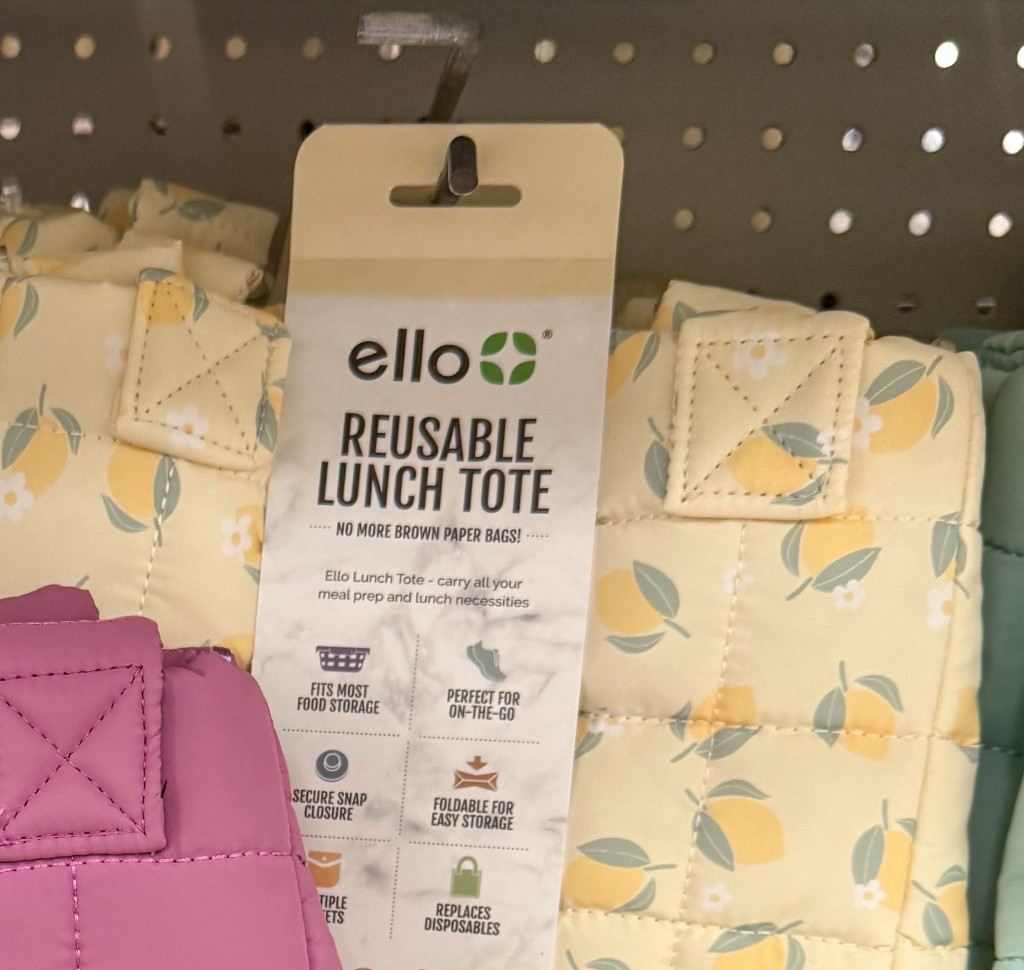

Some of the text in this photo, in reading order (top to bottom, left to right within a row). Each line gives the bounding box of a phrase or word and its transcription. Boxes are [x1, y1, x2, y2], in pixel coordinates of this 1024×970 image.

[348, 328, 470, 385] ello
[340, 412, 537, 463] REUSABLE
[317, 461, 553, 514] LUNCH TOTE
[336, 522, 521, 544] NO MORE BROWN PAPER BAGS!
[325, 571, 349, 582] Ello
[352, 571, 393, 585] Lunch
[396, 573, 425, 586] Tote
[437, 577, 471, 590] carry
[474, 576, 490, 589] all
[492, 578, 522, 591] your
[318, 590, 529, 608] meal prep and lunch necessities
[310, 682, 369, 698] FITS MOST
[447, 689, 520, 706] PERFECT FOR
[297, 697, 380, 715] FOOD STORAGE
[449, 705, 515, 721] ON-THE-GO
[293, 789, 367, 807] SECURE SNAP
[433, 798, 514, 815] FOLDABLE FOR
[304, 805, 353, 821] CLOSURE
[431, 812, 514, 831] EASY STORAGE
[319, 895, 347, 910] TIPLE
[436, 903, 491, 919] REPLACES
[424, 917, 500, 936] DISPOSABLES
